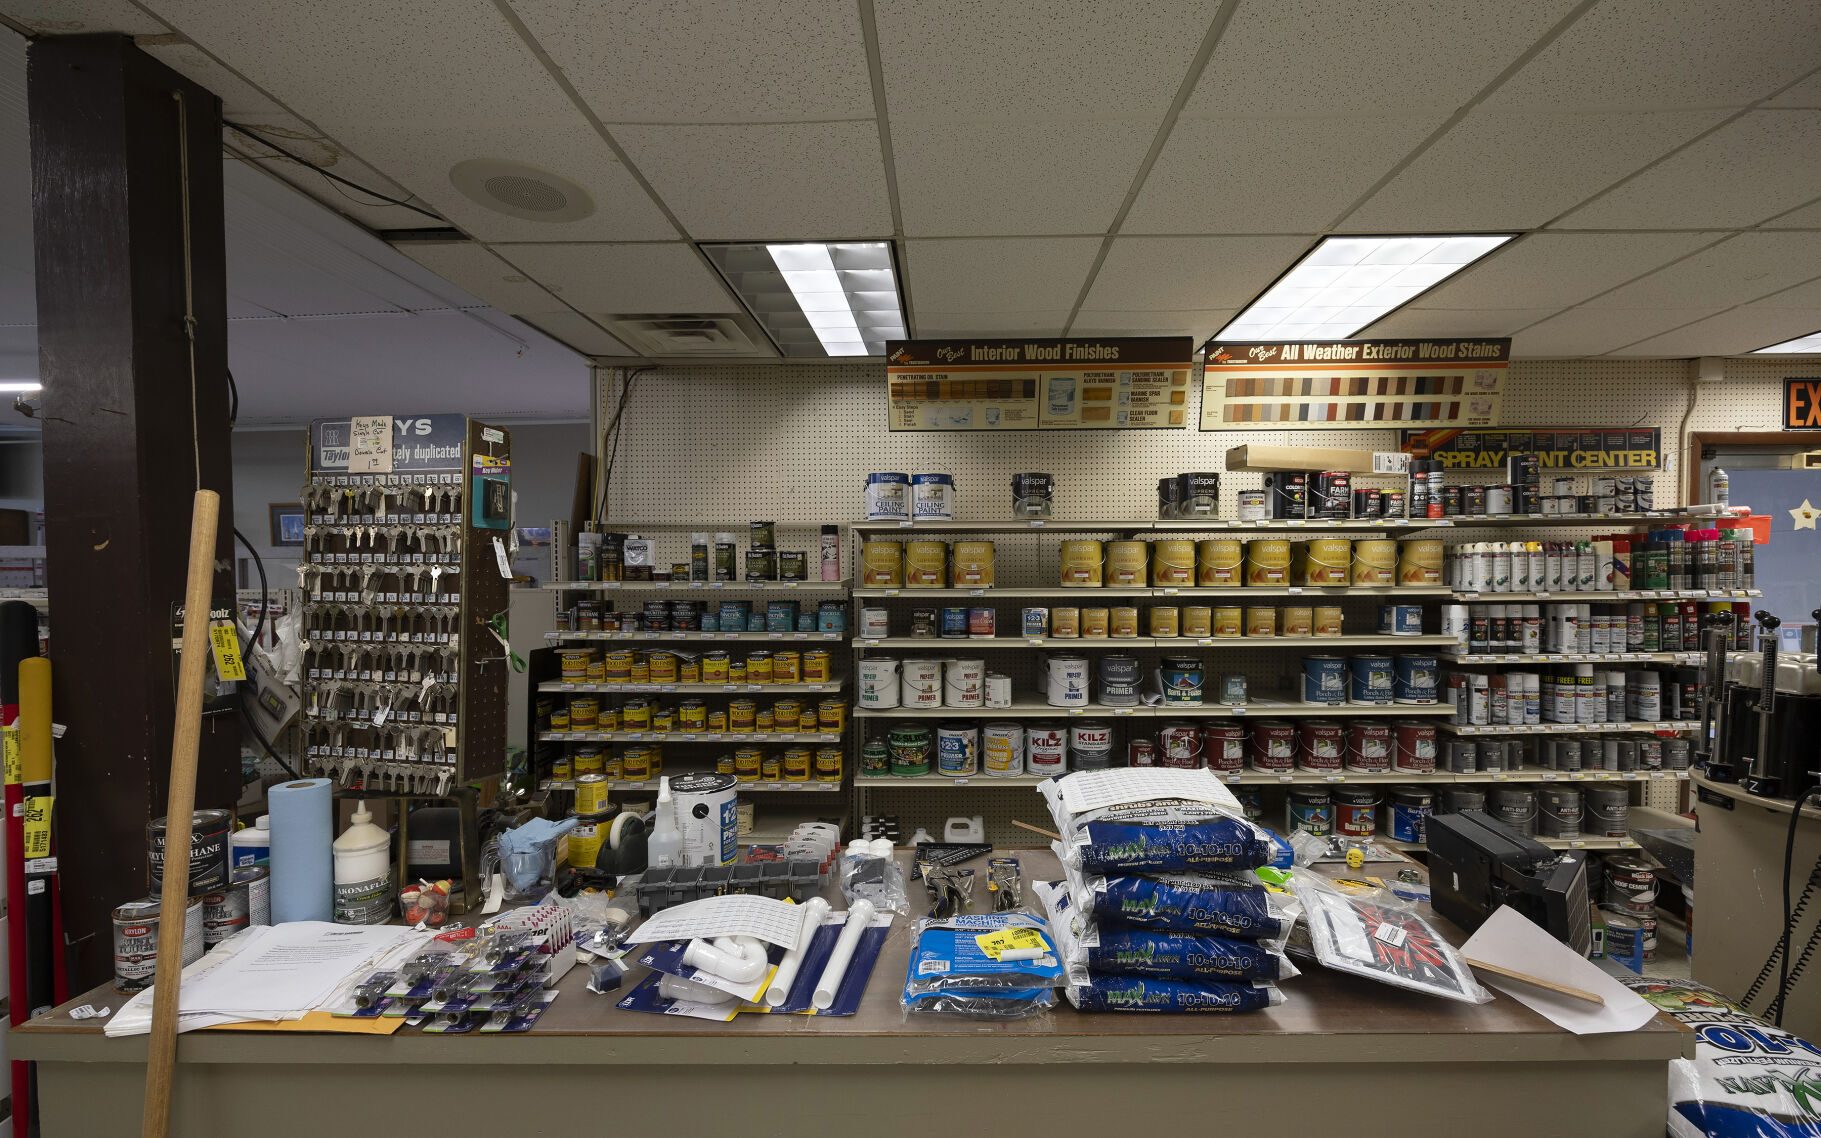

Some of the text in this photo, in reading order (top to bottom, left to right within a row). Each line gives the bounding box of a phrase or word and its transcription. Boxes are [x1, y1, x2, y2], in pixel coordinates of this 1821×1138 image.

[946, 348, 966, 362] Best
[971, 344, 1120, 360] Interior Wood Finishes
[1258, 347, 1277, 362] Best
[1280, 342, 1502, 360] All Weather Exterior Wood Stains
[414, 442, 461, 463] duplicated
[1434, 451, 1656, 468] SPRAY CENTER
[1022, 478, 1046, 486] valspar
[1190, 477, 1216, 486] valspar
[960, 546, 985, 554] valspar
[1069, 544, 1094, 553] valspar
[1168, 544, 1192, 552] valspar
[1262, 545, 1287, 553] valspar
[1324, 545, 1349, 553] valspar
[223, 654, 235, 666] 262
[1107, 664, 1133, 674] valspar
[1032, 737, 1062, 746] KILZ
[1078, 733, 1106, 741] KILZ
[1705, 766, 1711, 777] X
[1749, 780, 1759, 792] Z
[1109, 801, 1152, 812] shrubs
[26, 808, 43, 822] 262
[1178, 844, 1242, 856] 10-10-10
[1188, 907, 1252, 928] 10-10-10
[121, 936, 152, 945] RUST
[119, 944, 154, 953] TOUGH
[1187, 953, 1252, 969] 10-10-10
[1177, 993, 1241, 1006] 10-10-10
[1712, 1056, 1774, 1066] FERTILIZER
